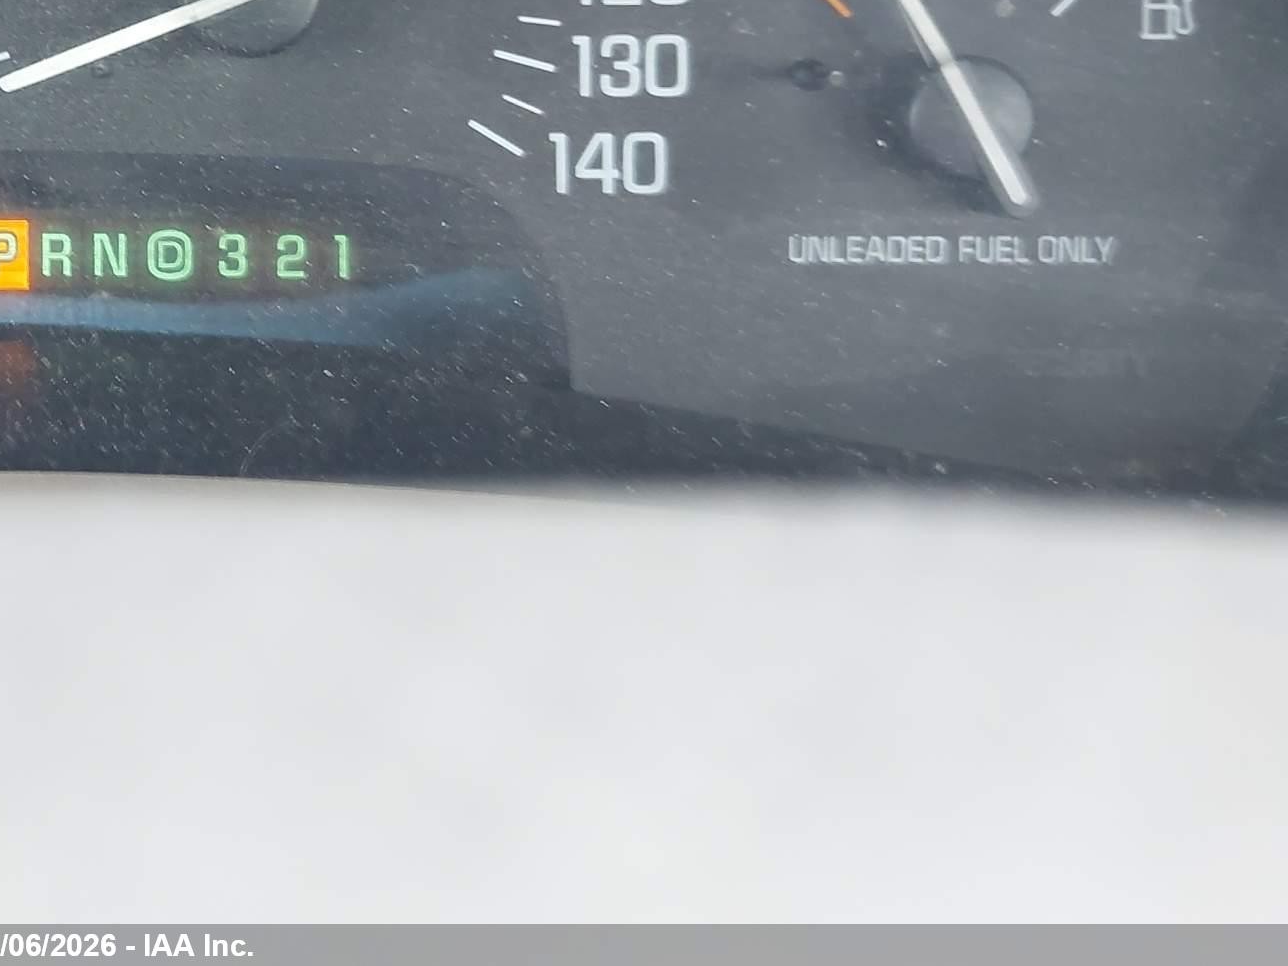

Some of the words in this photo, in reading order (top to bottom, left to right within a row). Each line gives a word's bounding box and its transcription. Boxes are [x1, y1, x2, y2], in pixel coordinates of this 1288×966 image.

[572, 34, 689, 98] 130
[548, 131, 668, 195] 140
[41, 232, 72, 277] R
[93, 232, 128, 277] N
[218, 233, 249, 277] 3
[276, 234, 307, 279] 2
[334, 234, 349, 280] 1
[788, 235, 948, 264] UNLEADED
[958, 235, 1030, 264] FUEL
[1037, 235, 1114, 264] ONLY
